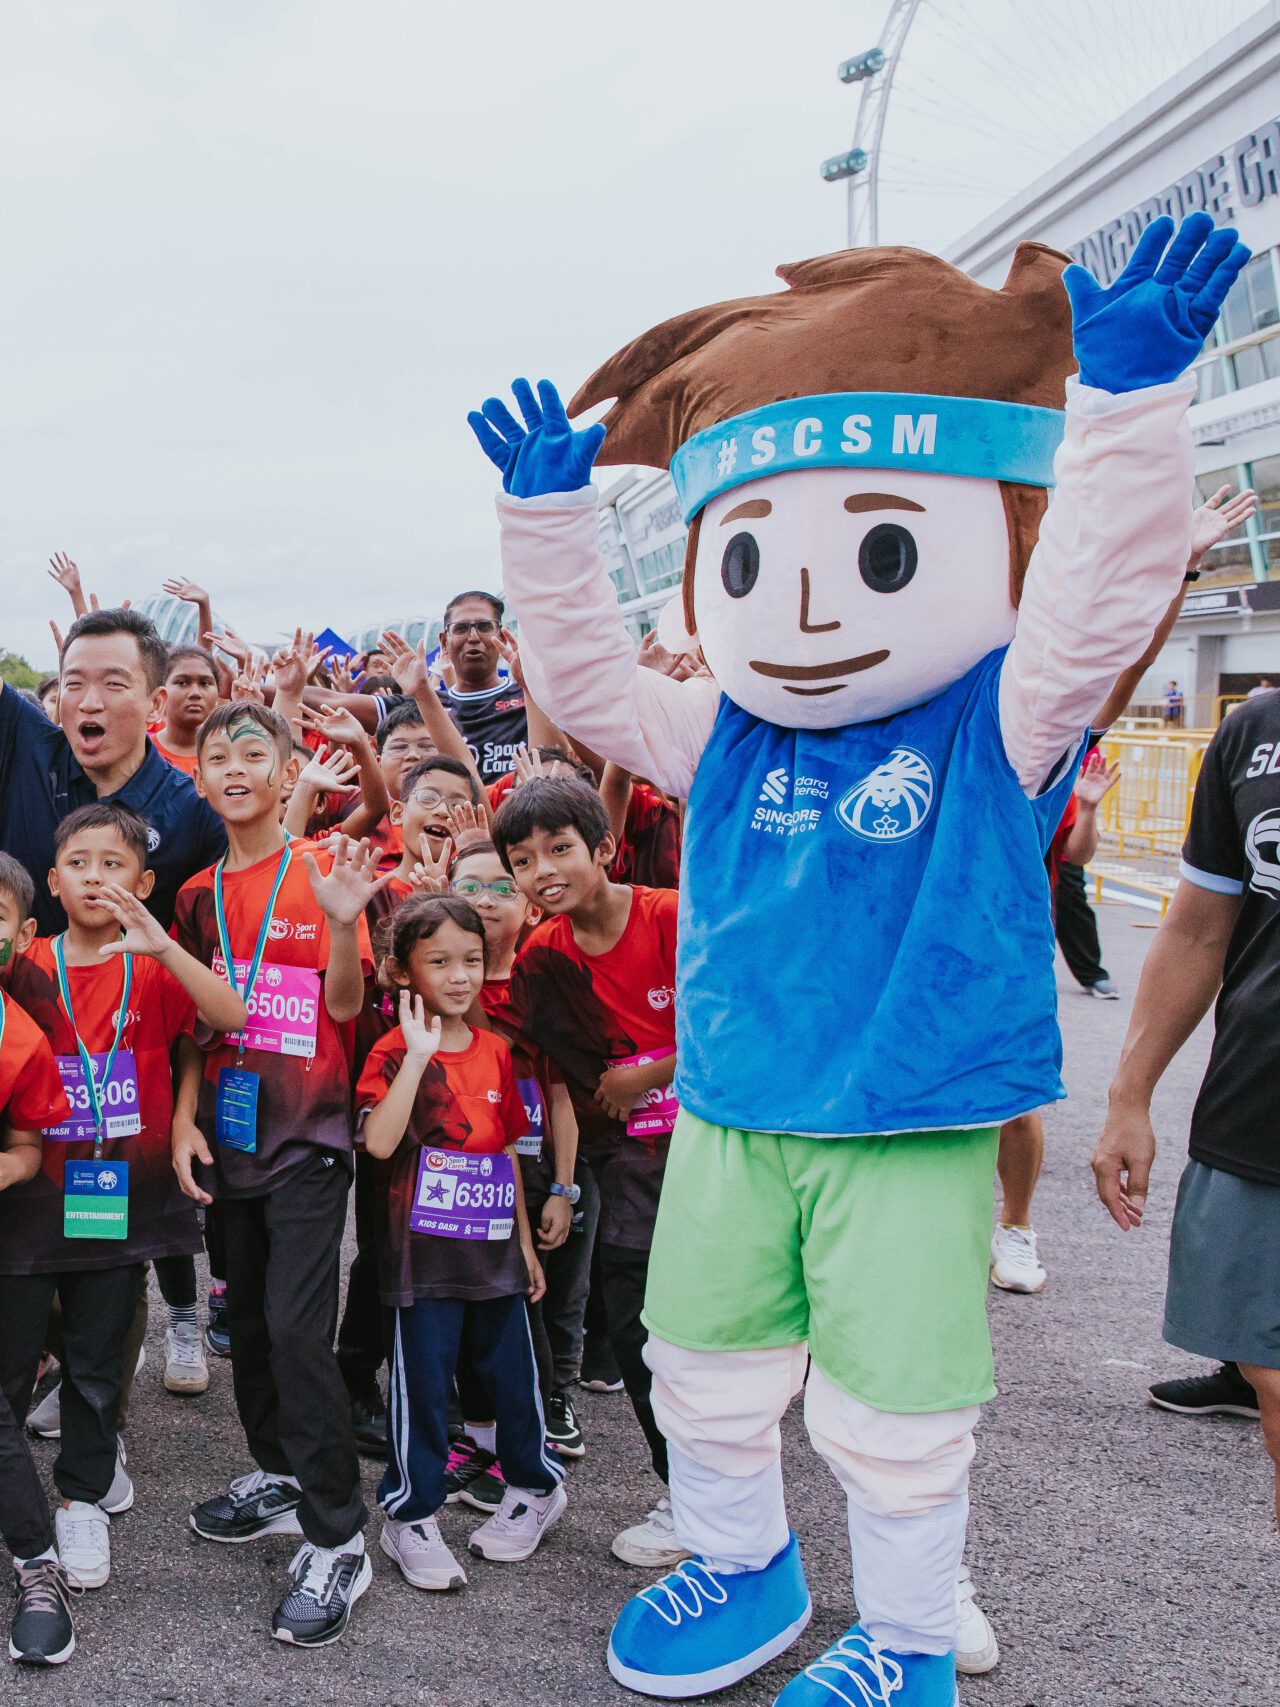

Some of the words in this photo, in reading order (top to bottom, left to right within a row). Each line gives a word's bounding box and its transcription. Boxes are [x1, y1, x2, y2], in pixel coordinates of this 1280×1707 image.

[716, 413, 938, 477] #SCSM
[482, 758, 517, 774] Care
[245, 990, 315, 1024] 65005
[49, 1127, 70, 1135] DASH
[455, 1182, 515, 1208] 63318
[418, 1219, 437, 1229] KIDS
[437, 1222, 459, 1232] DASH
